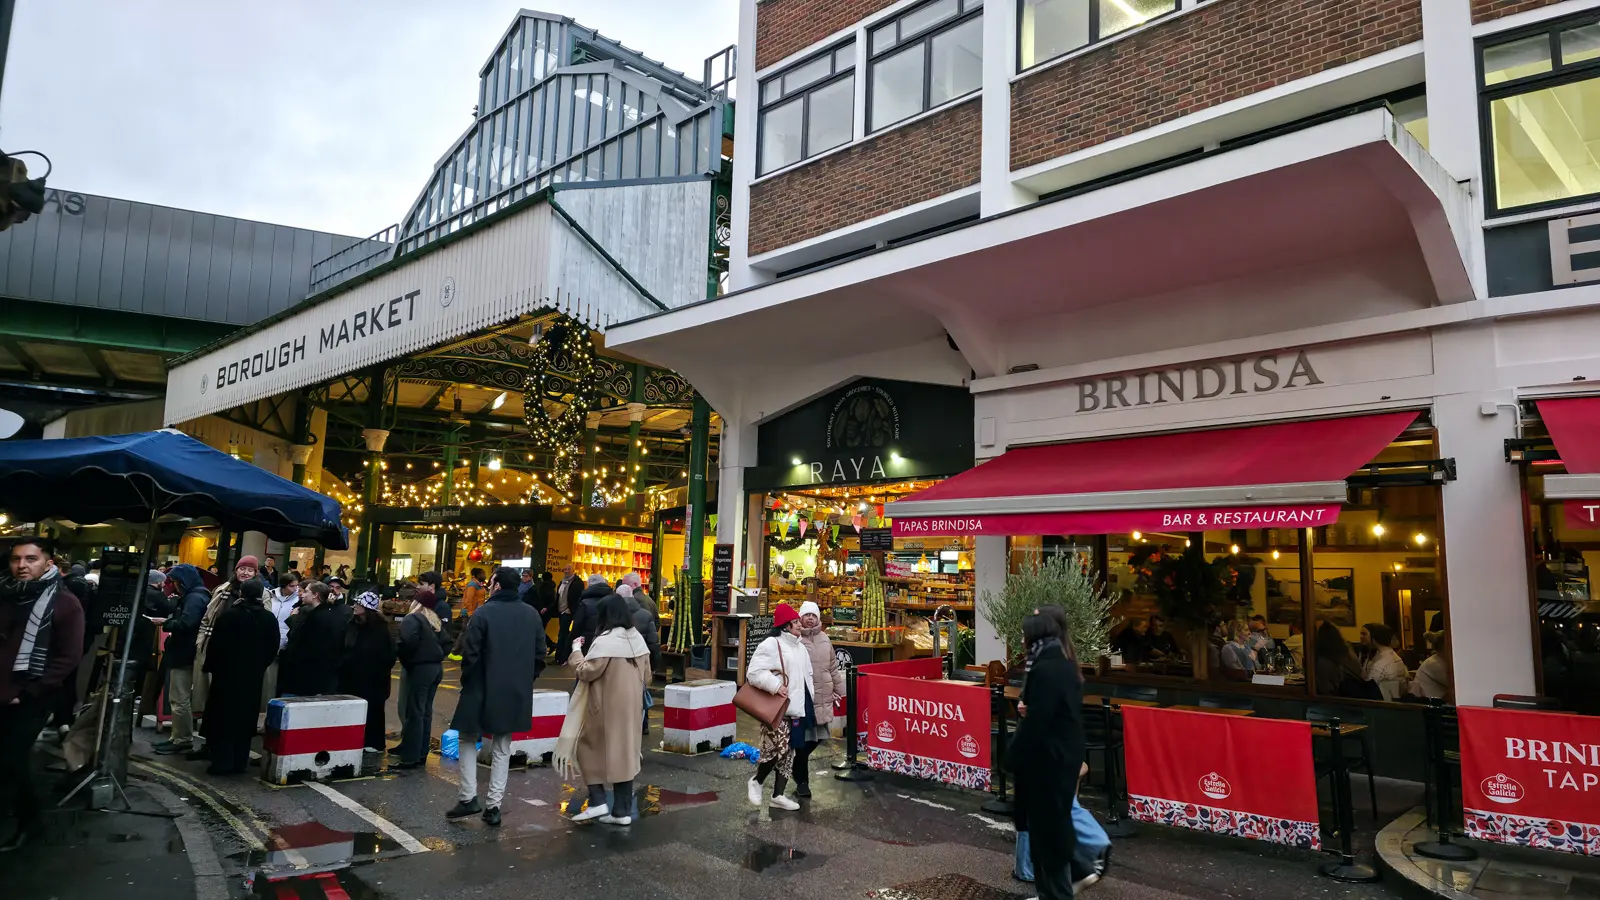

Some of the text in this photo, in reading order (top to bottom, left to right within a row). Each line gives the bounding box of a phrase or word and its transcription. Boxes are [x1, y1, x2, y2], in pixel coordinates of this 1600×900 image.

[216, 335, 306, 389] BOROUGH
[319, 289, 420, 353] MARKET
[1075, 350, 1324, 412] BRINDISA
[827, 413, 835, 448] SOUTHEAST
[811, 456, 886, 483] RAYA
[899, 519, 982, 532] TAPAS BRINDISA
[1163, 509, 1326, 526] BAR & RESTAURANT
[888, 695, 965, 722] BRINDISA
[904, 717, 948, 738] TAPAS
[1204, 779, 1225, 788] Estrella
[1487, 781, 1517, 791] Estrella
[1489, 788, 1516, 797] Galicia
